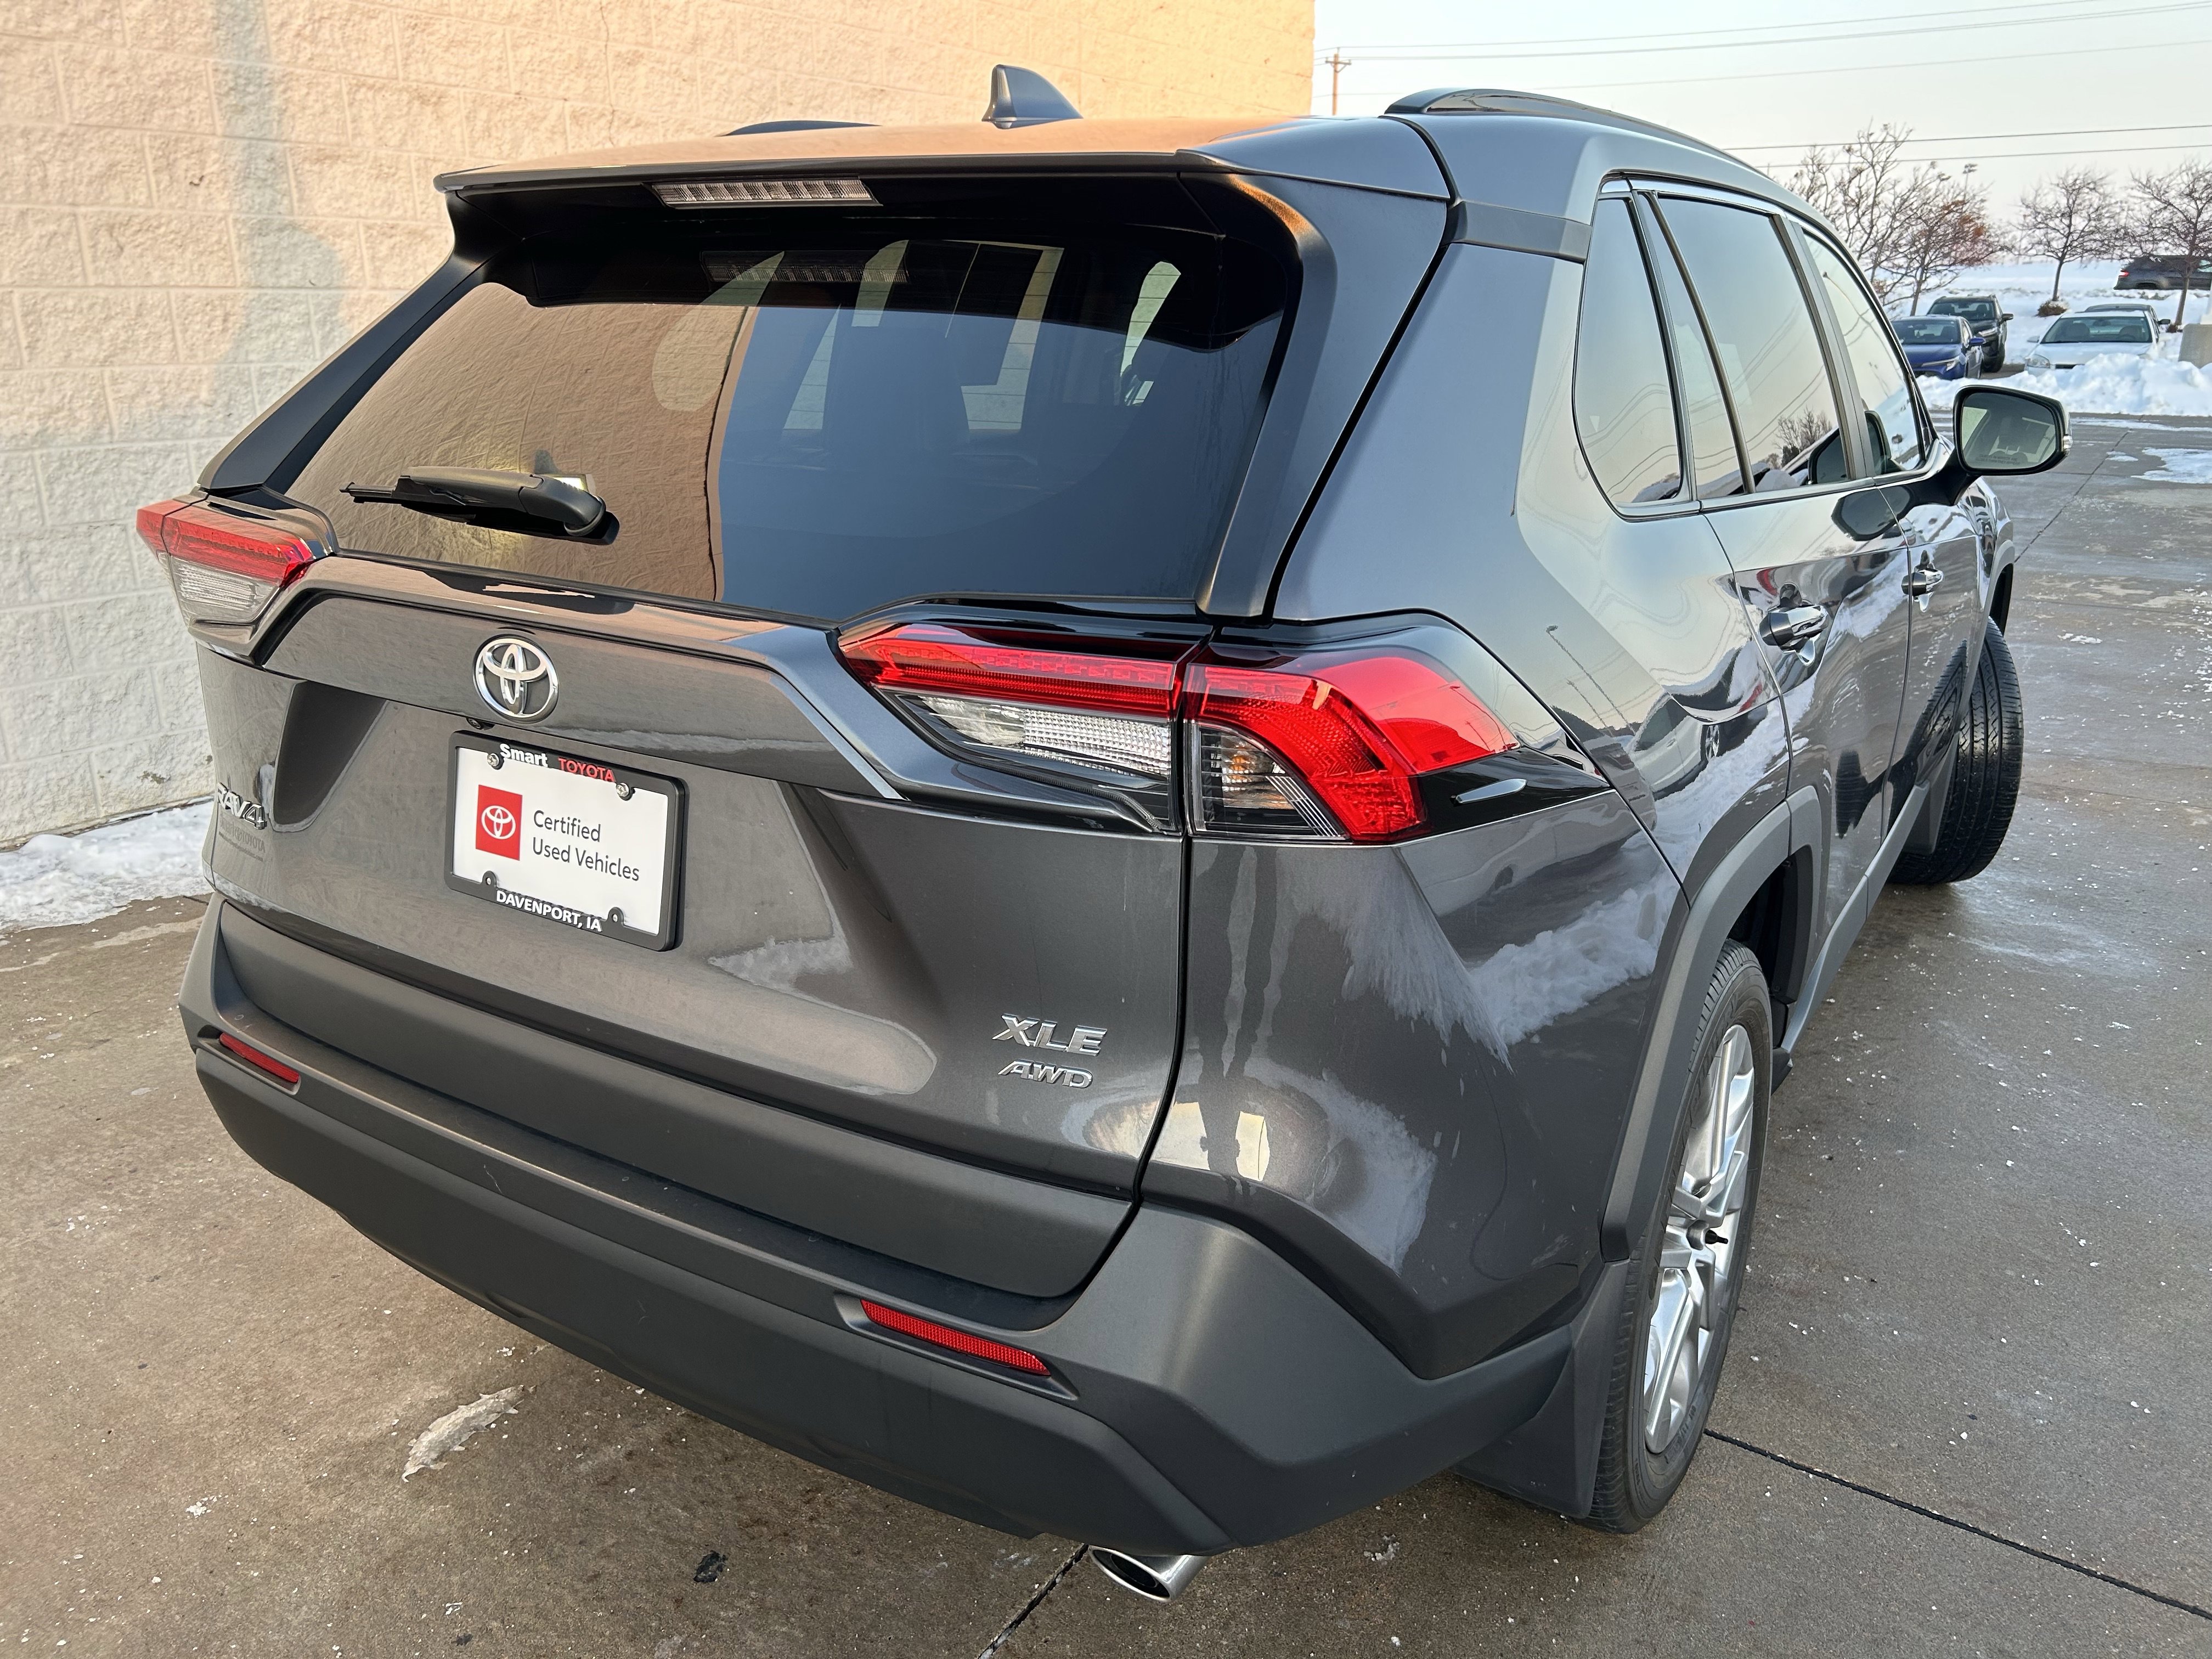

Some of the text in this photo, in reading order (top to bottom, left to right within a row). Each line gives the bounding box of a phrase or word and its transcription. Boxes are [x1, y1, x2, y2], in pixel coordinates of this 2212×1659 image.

[500, 743, 616, 783] Smart TOYOTA
[533, 810, 601, 842] Certified
[533, 837, 640, 881] Used Vehicles
[496, 890, 602, 932] DAVENPORT, IA
[992, 1013, 1108, 1056] XLE
[998, 1059, 1093, 1088] AWD
